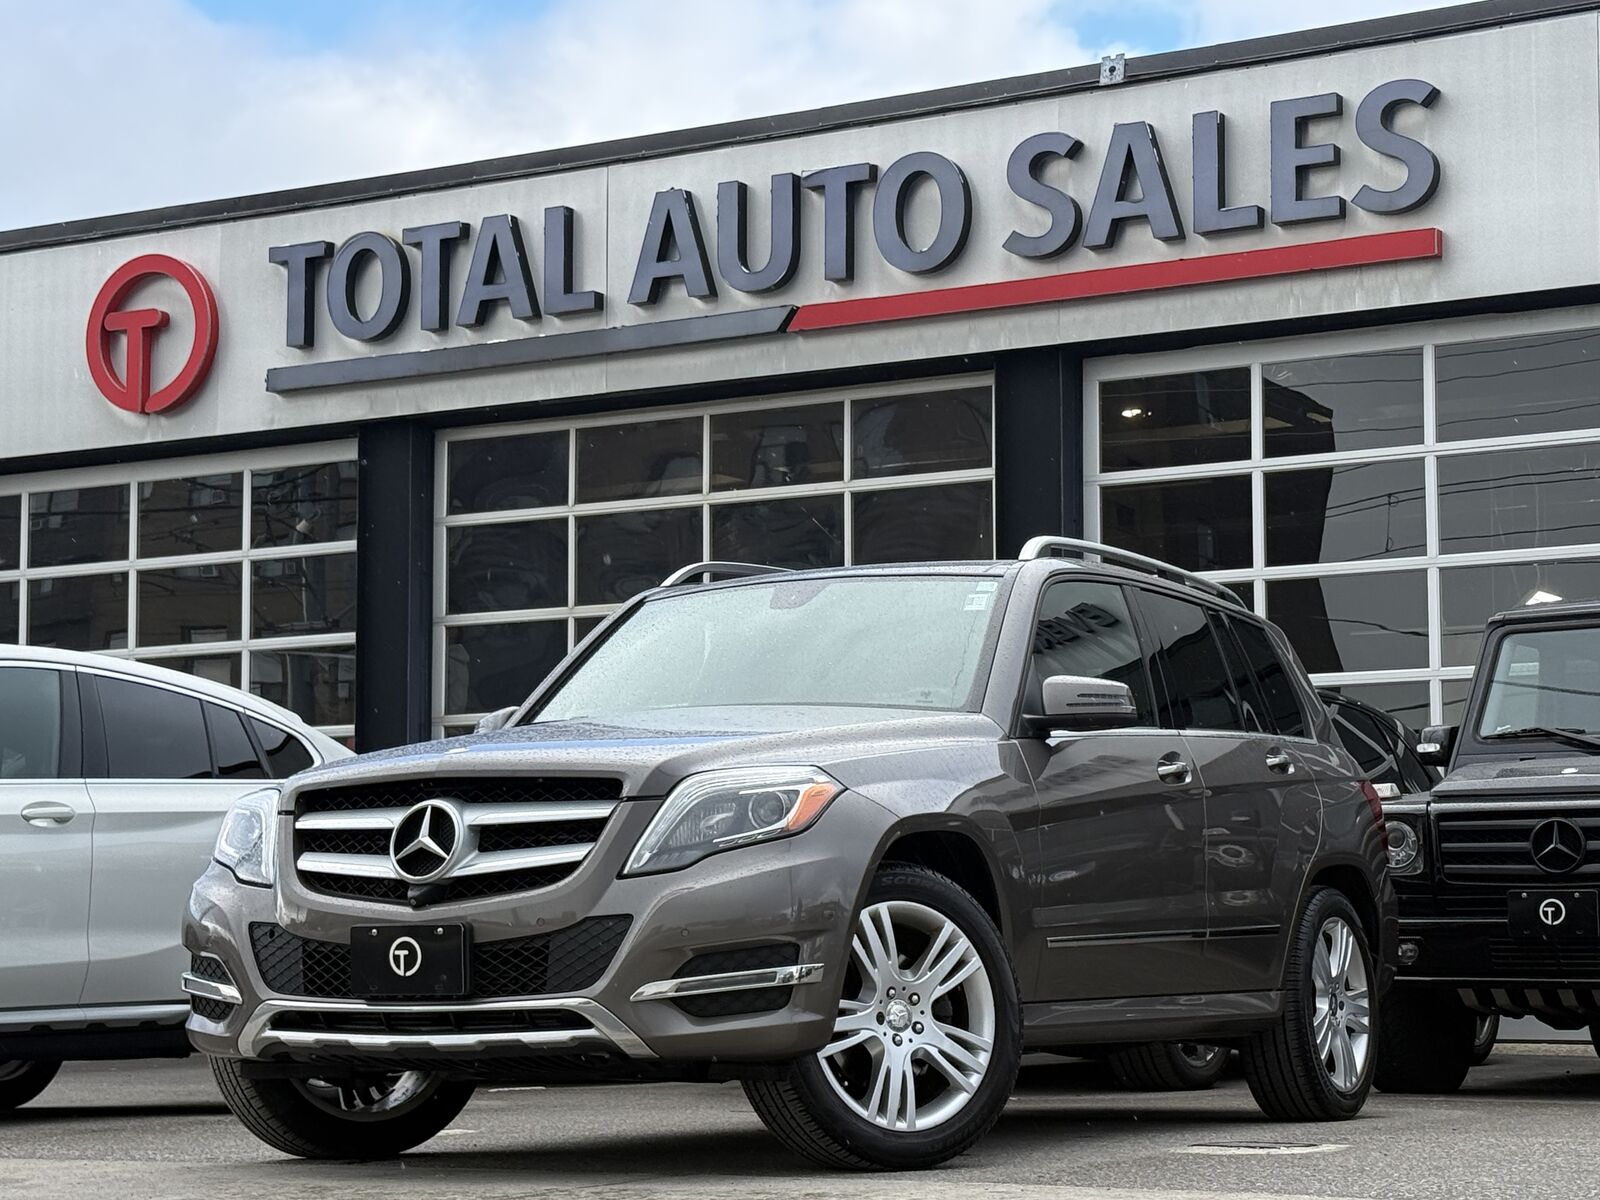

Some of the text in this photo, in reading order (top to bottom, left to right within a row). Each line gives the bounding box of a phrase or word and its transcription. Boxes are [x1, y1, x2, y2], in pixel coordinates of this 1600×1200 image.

[269, 79, 1441, 350] TOTAL AUTO SALES
